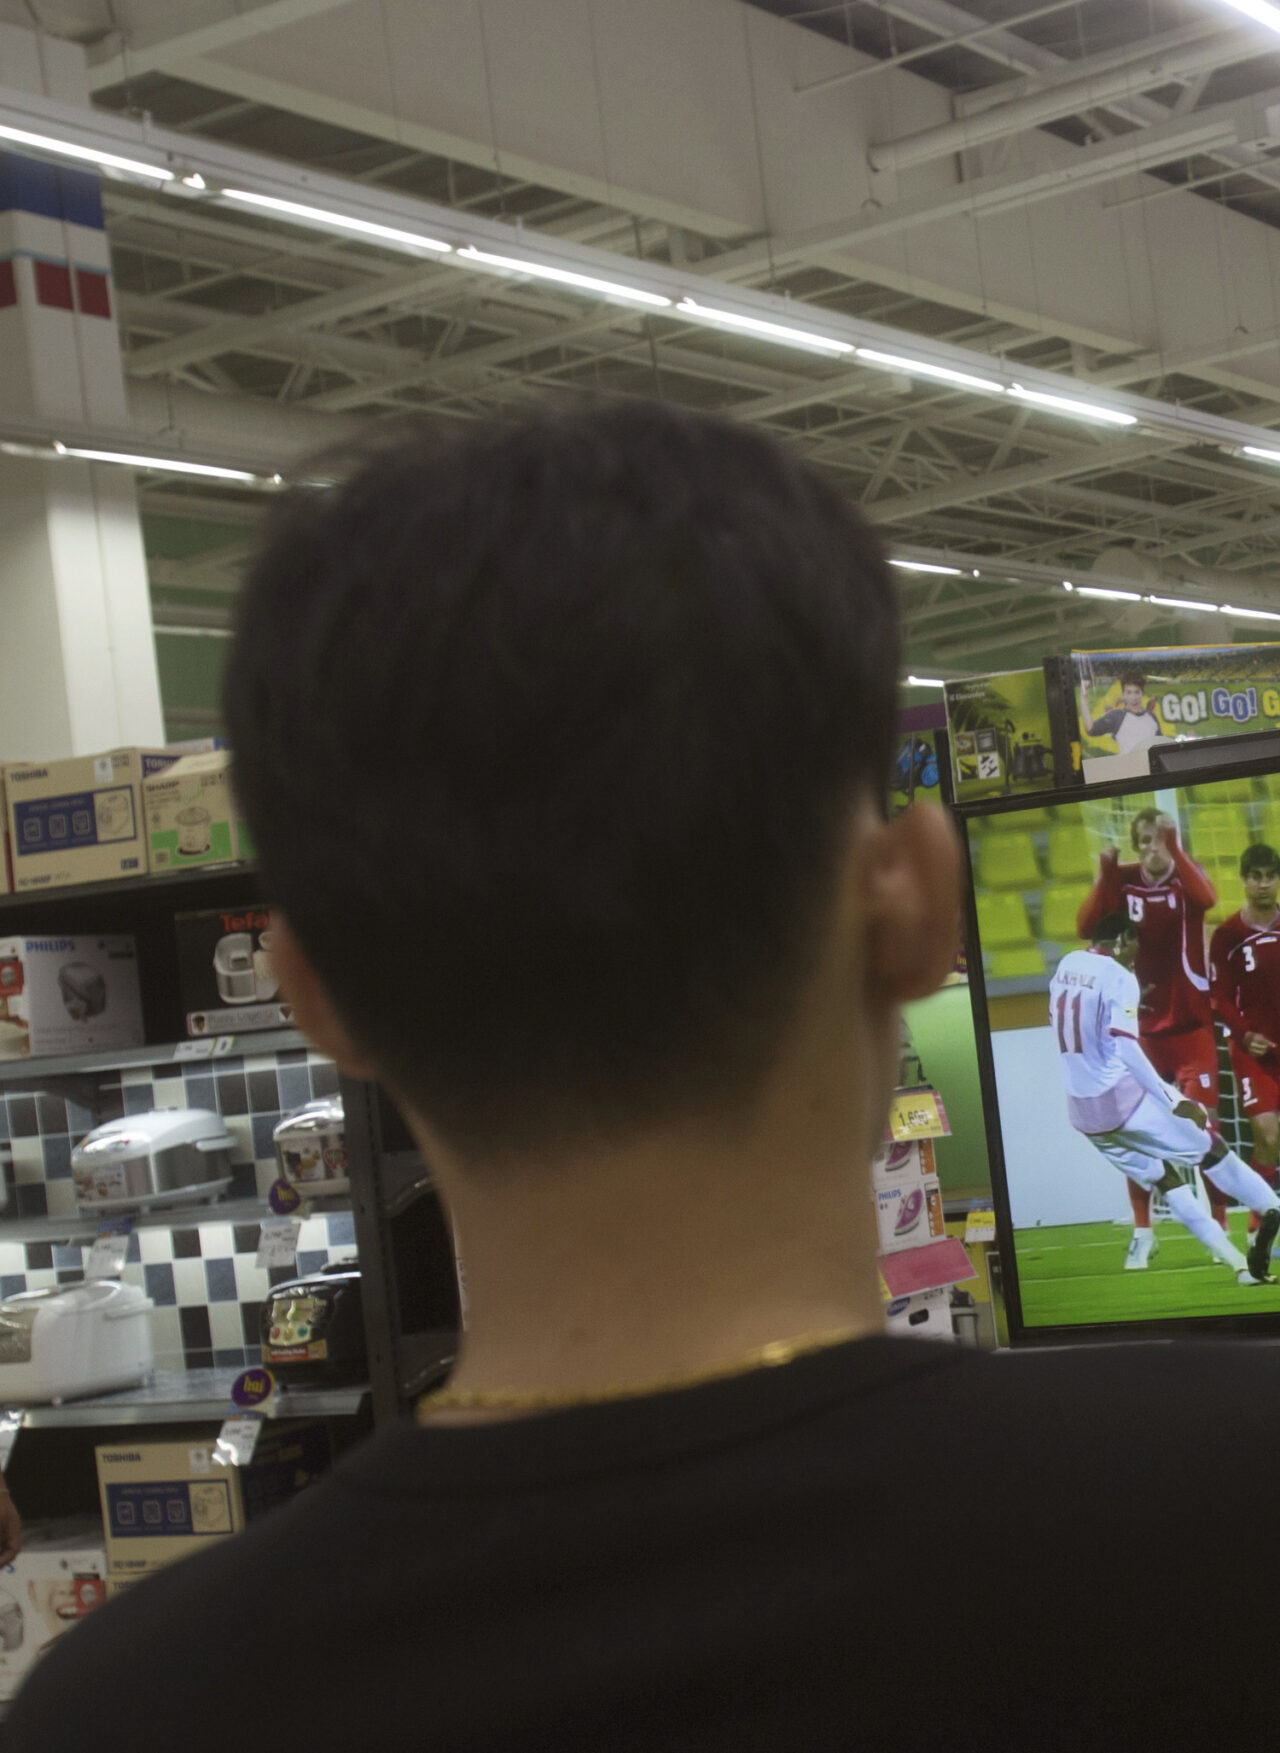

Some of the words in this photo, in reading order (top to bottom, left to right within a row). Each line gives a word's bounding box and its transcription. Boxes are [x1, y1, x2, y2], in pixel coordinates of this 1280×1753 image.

[25, 939, 75, 953] PHILIPS
[1242, 946, 1256, 972] 3
[1056, 989, 1085, 1053] 11
[1241, 1077, 1254, 1099] 3
